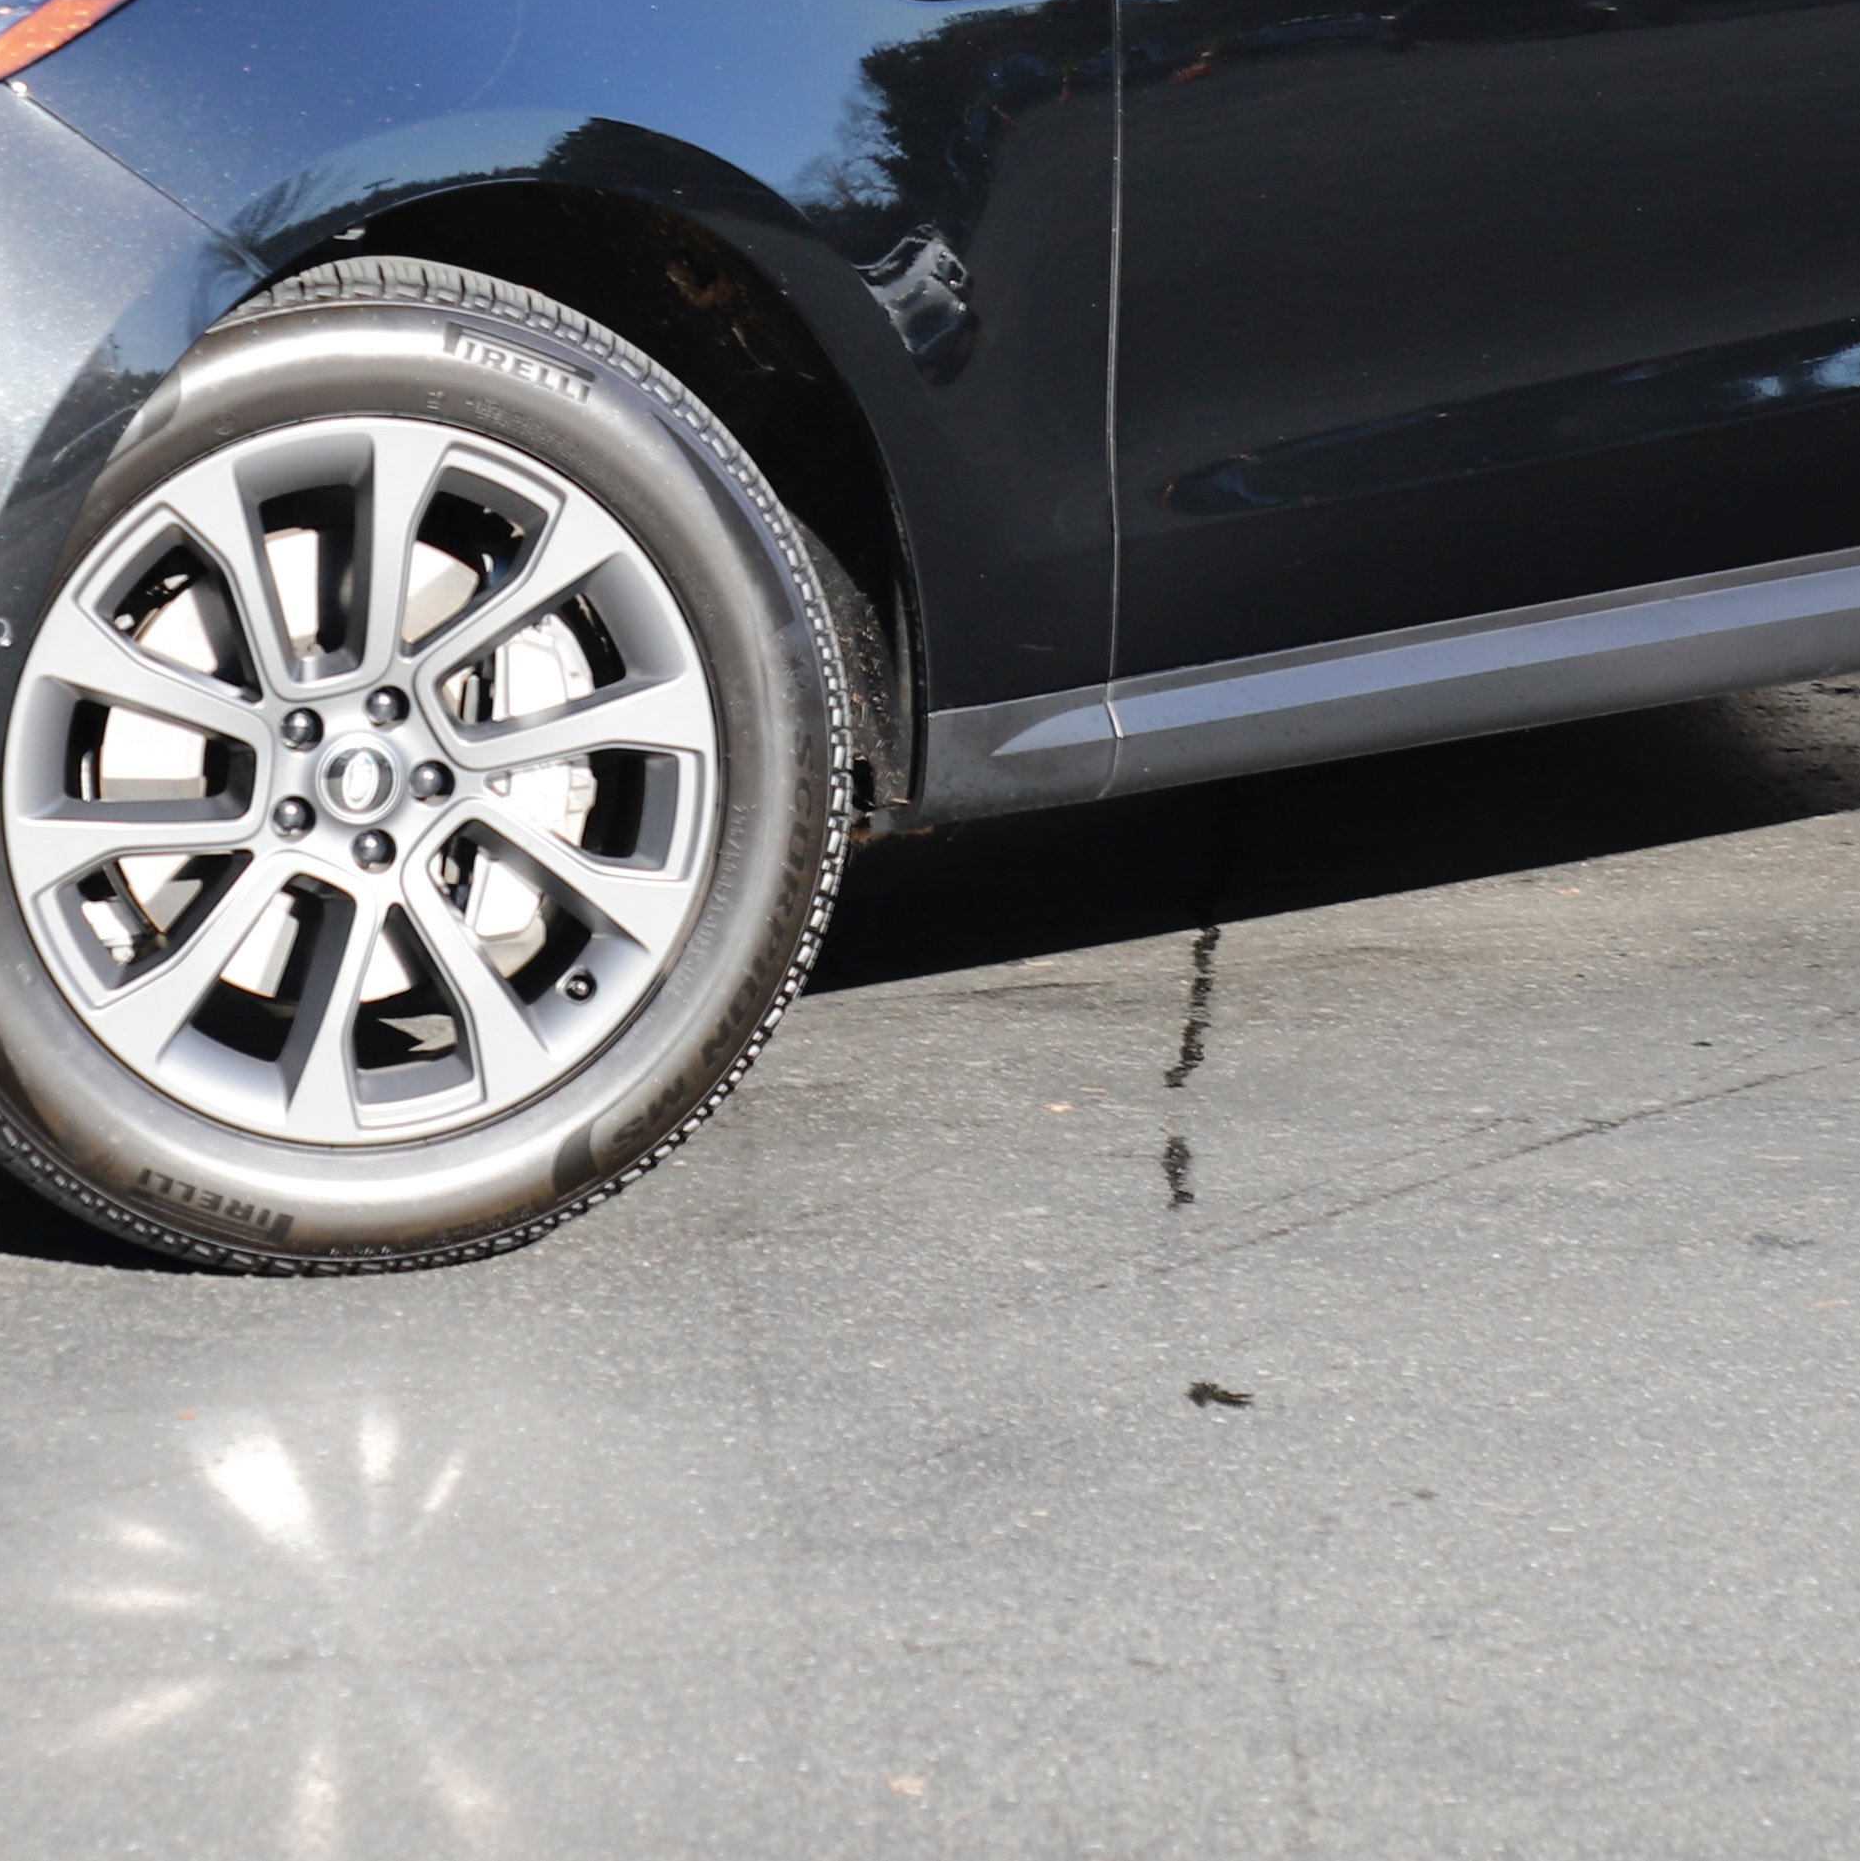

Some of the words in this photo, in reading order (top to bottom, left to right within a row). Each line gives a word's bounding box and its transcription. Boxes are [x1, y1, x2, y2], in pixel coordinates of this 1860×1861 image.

[443, 320, 596, 405] PIRELLI
[699, 728, 813, 1069] SCORPION
[129, 1166, 294, 1248] PIRELLI
